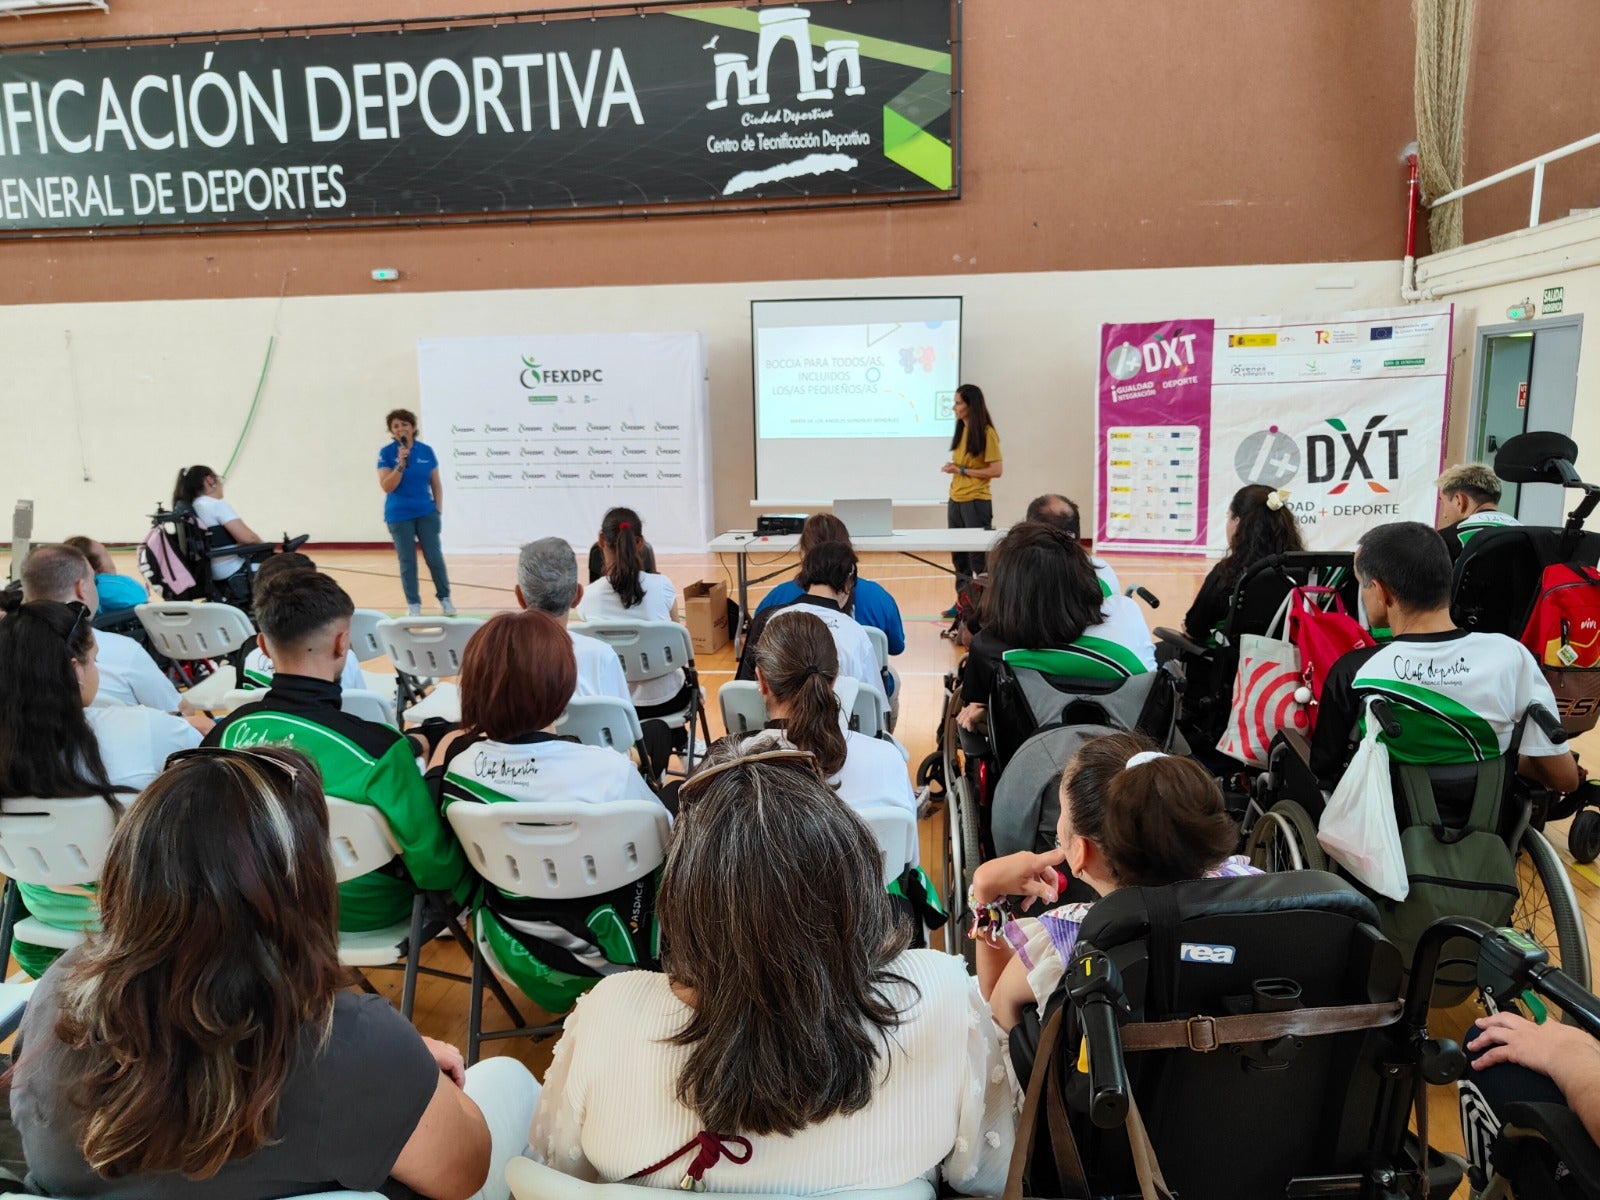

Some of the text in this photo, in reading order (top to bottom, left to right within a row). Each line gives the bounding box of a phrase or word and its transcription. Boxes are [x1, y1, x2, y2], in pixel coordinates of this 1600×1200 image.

[0, 47, 645, 155] FICACIÓN DEPORTIVA
[741, 108, 834, 127] Ciudad Deportiva
[706, 128, 871, 153] Centro de Tecnificación Deportiva
[0, 164, 347, 220] ENERAL DE DEPORTES
[1142, 333, 1197, 373] DXT
[765, 358, 801, 369] BOCCIA
[804, 357, 828, 368] PARA
[543, 369, 603, 383] FEXDPC
[1162, 376, 1199, 389] DEPORTE
[1306, 428, 1408, 484] DXT
[1333, 503, 1400, 516] DEPORTE
[1181, 945, 1233, 962] rea
